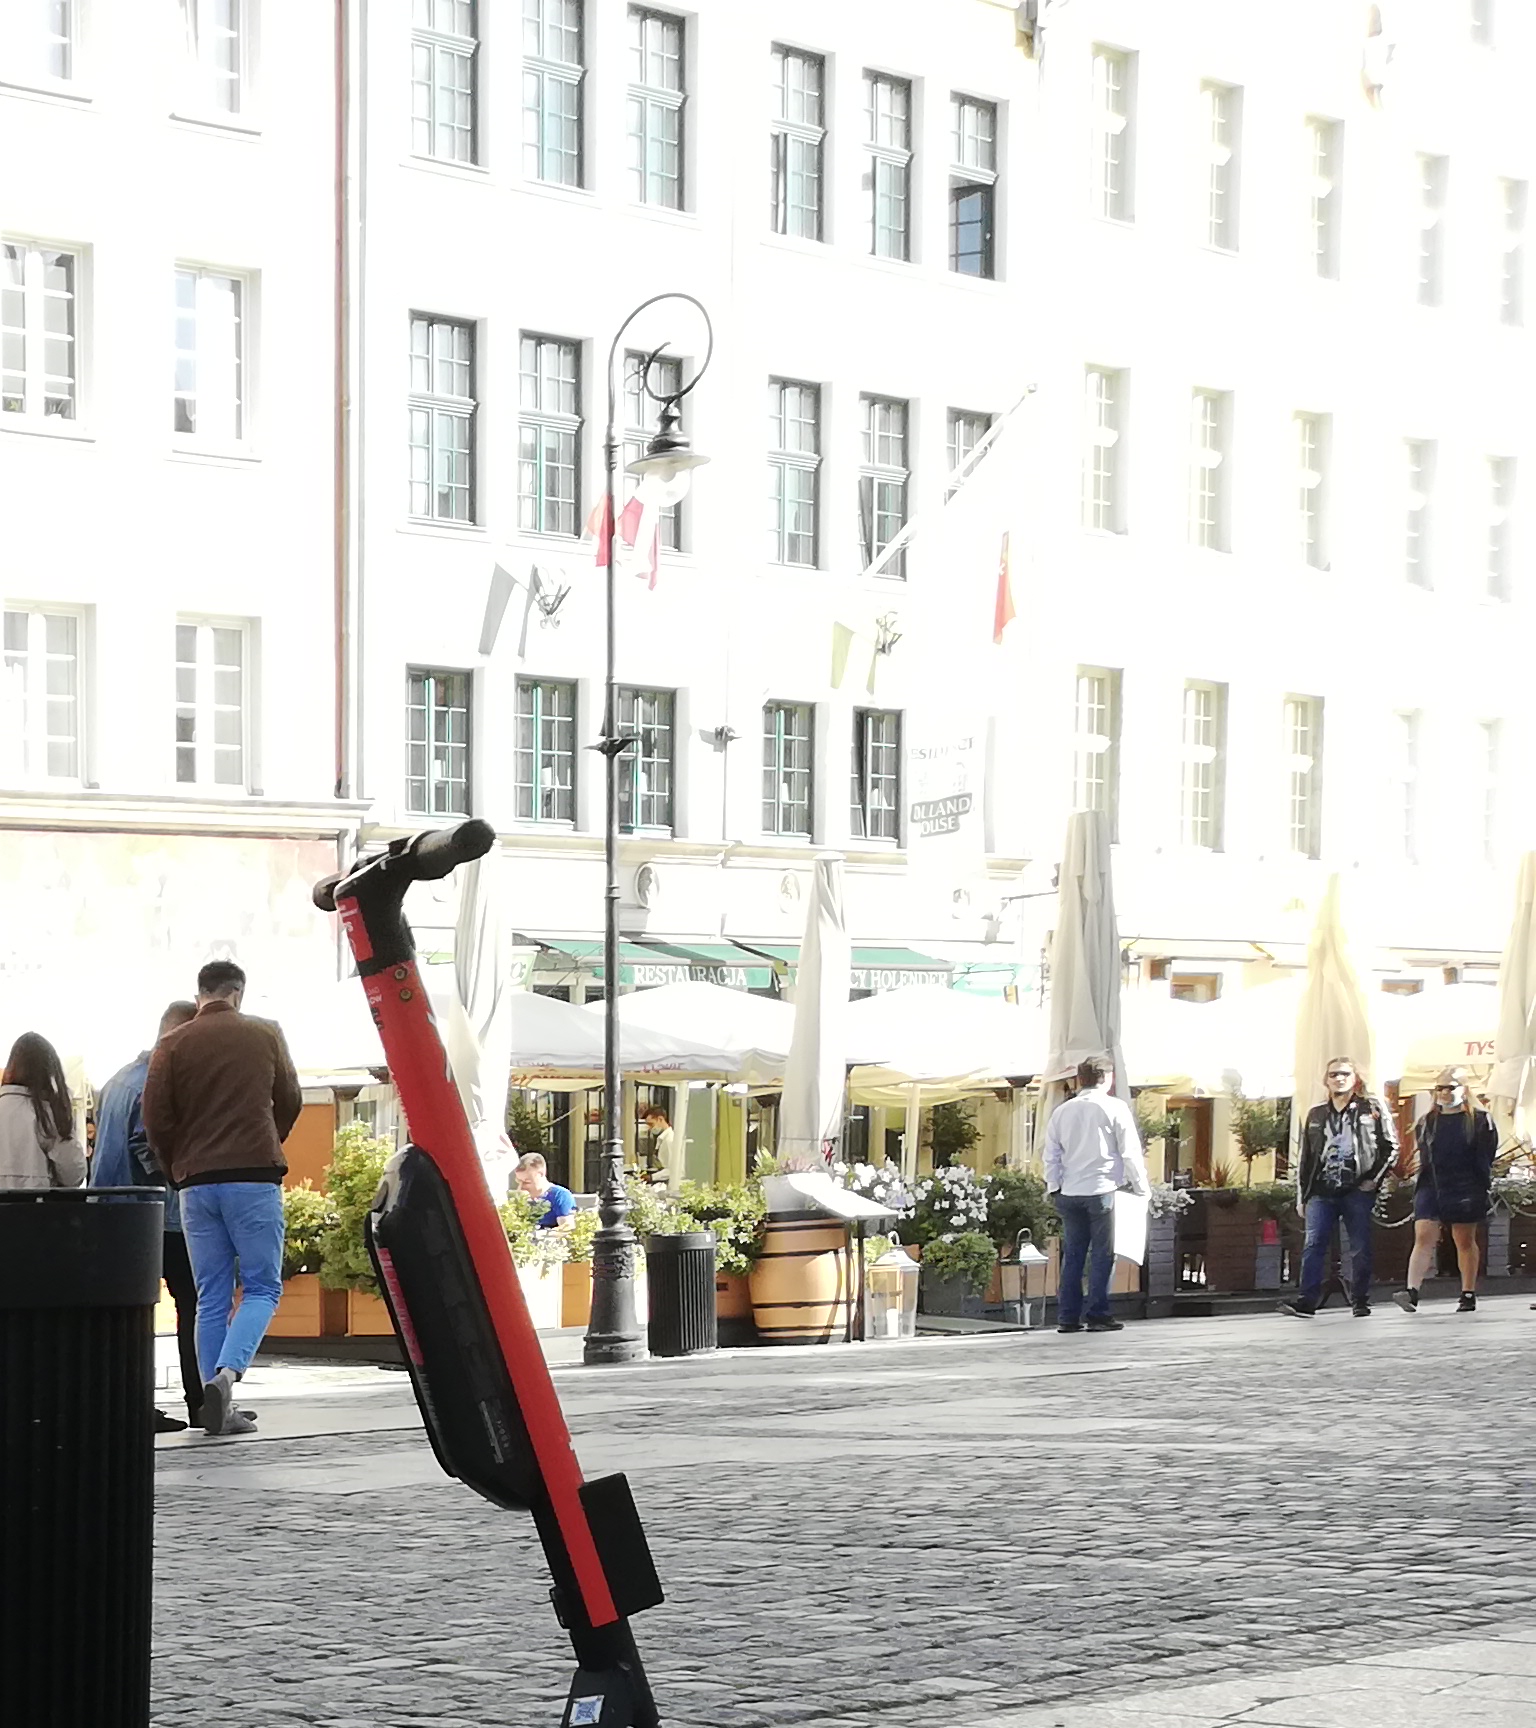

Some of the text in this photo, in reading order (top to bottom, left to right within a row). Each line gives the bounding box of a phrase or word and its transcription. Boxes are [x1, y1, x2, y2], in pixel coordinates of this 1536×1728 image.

[913, 796, 970, 821] OLLAND
[921, 815, 957, 835] OUSE
[633, 965, 748, 987] RESTAURACJA
